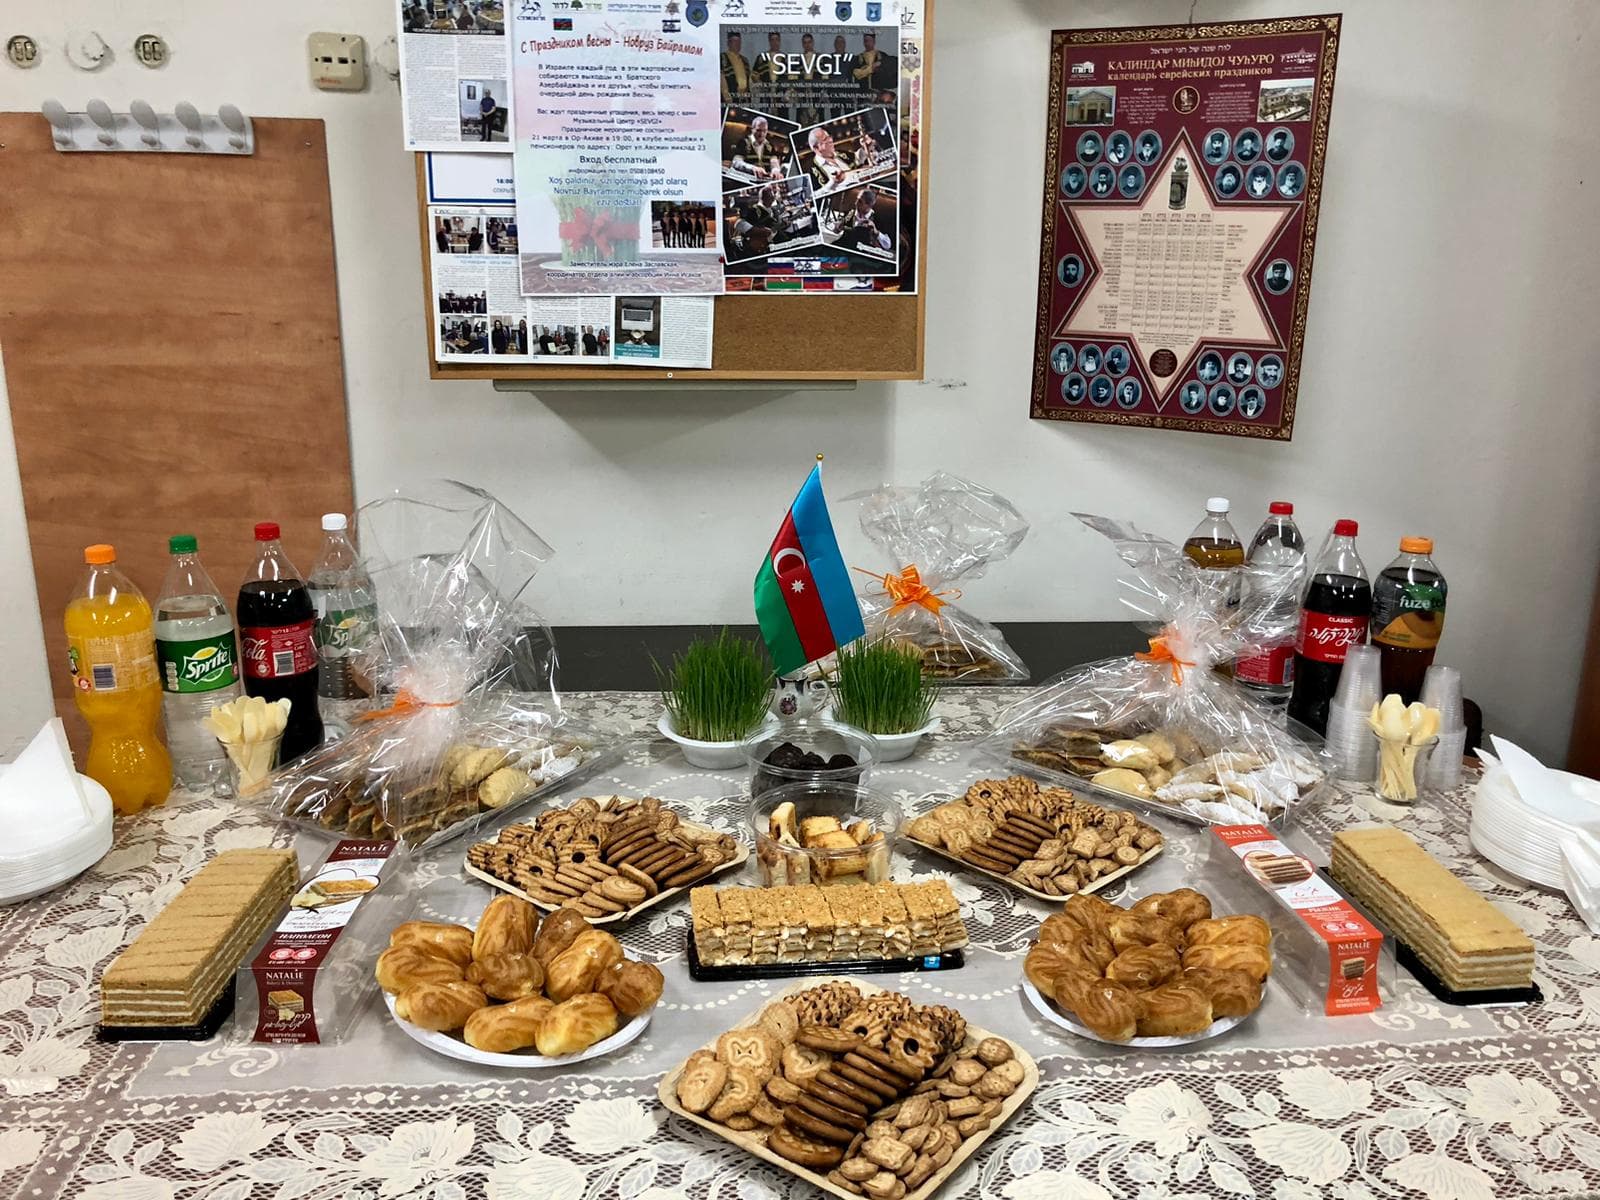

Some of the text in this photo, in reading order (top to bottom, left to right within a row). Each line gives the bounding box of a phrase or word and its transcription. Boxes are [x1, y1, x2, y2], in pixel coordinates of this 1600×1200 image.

[530, 37, 584, 55] Праздником
[587, 34, 611, 48] весны
[623, 35, 654, 52] Новруз
[656, 38, 703, 56] Байрамом
[1150, 47, 1173, 55] ישראל
[1108, 58, 1170, 71] КАЛИНДАР
[1107, 70, 1158, 81] календарь
[1159, 69, 1211, 81] еврейских
[1214, 67, 1273, 79] праздников
[580, 155, 657, 164] Вход бесплатный
[553, 187, 581, 195] Novruz
[1399, 595, 1431, 609] fuze
[1328, 616, 1354, 624] CLASSIC
[185, 650, 229, 680] Sprite
